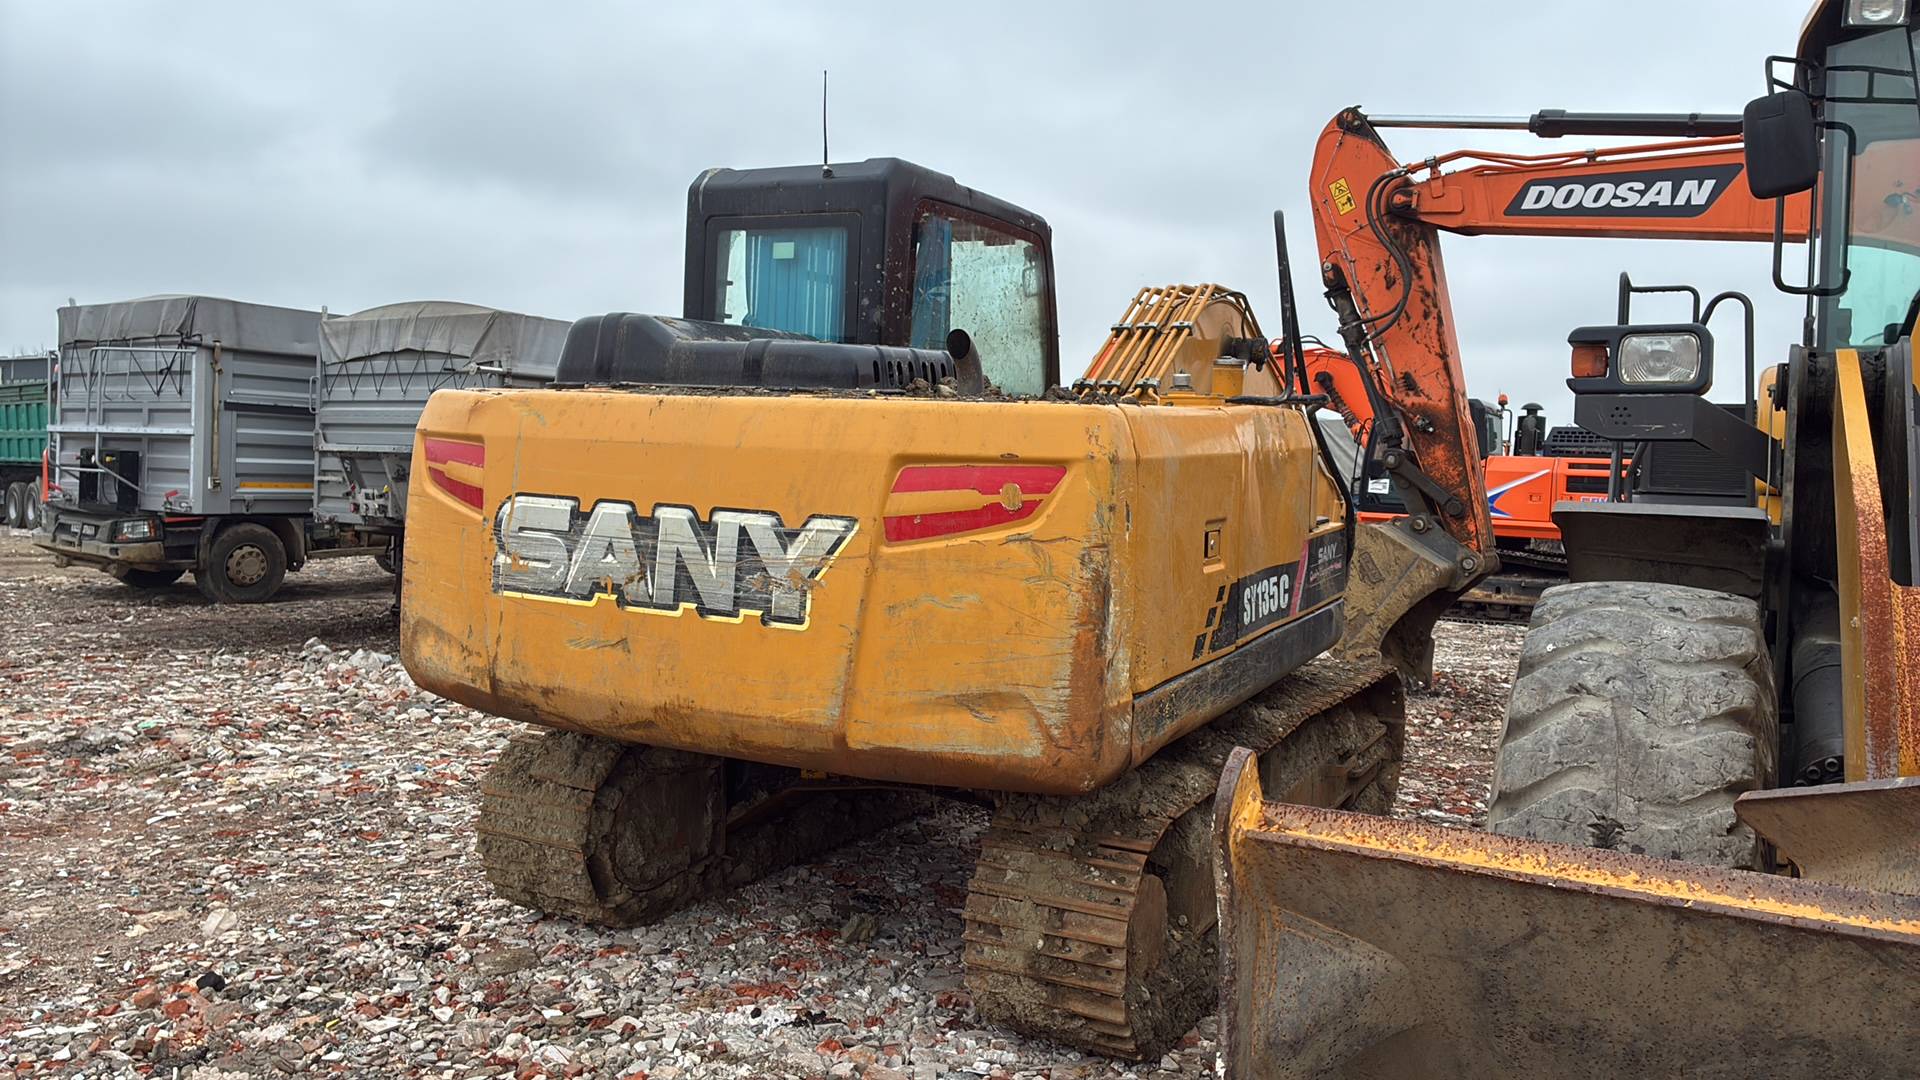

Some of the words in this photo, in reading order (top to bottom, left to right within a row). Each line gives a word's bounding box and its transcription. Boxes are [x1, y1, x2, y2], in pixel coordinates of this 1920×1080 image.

[1520, 179, 1717, 210] DOOSAN
[493, 493, 859, 624] SANY
[1318, 542, 1338, 560] SANY
[1243, 574, 1290, 626] SY135C
